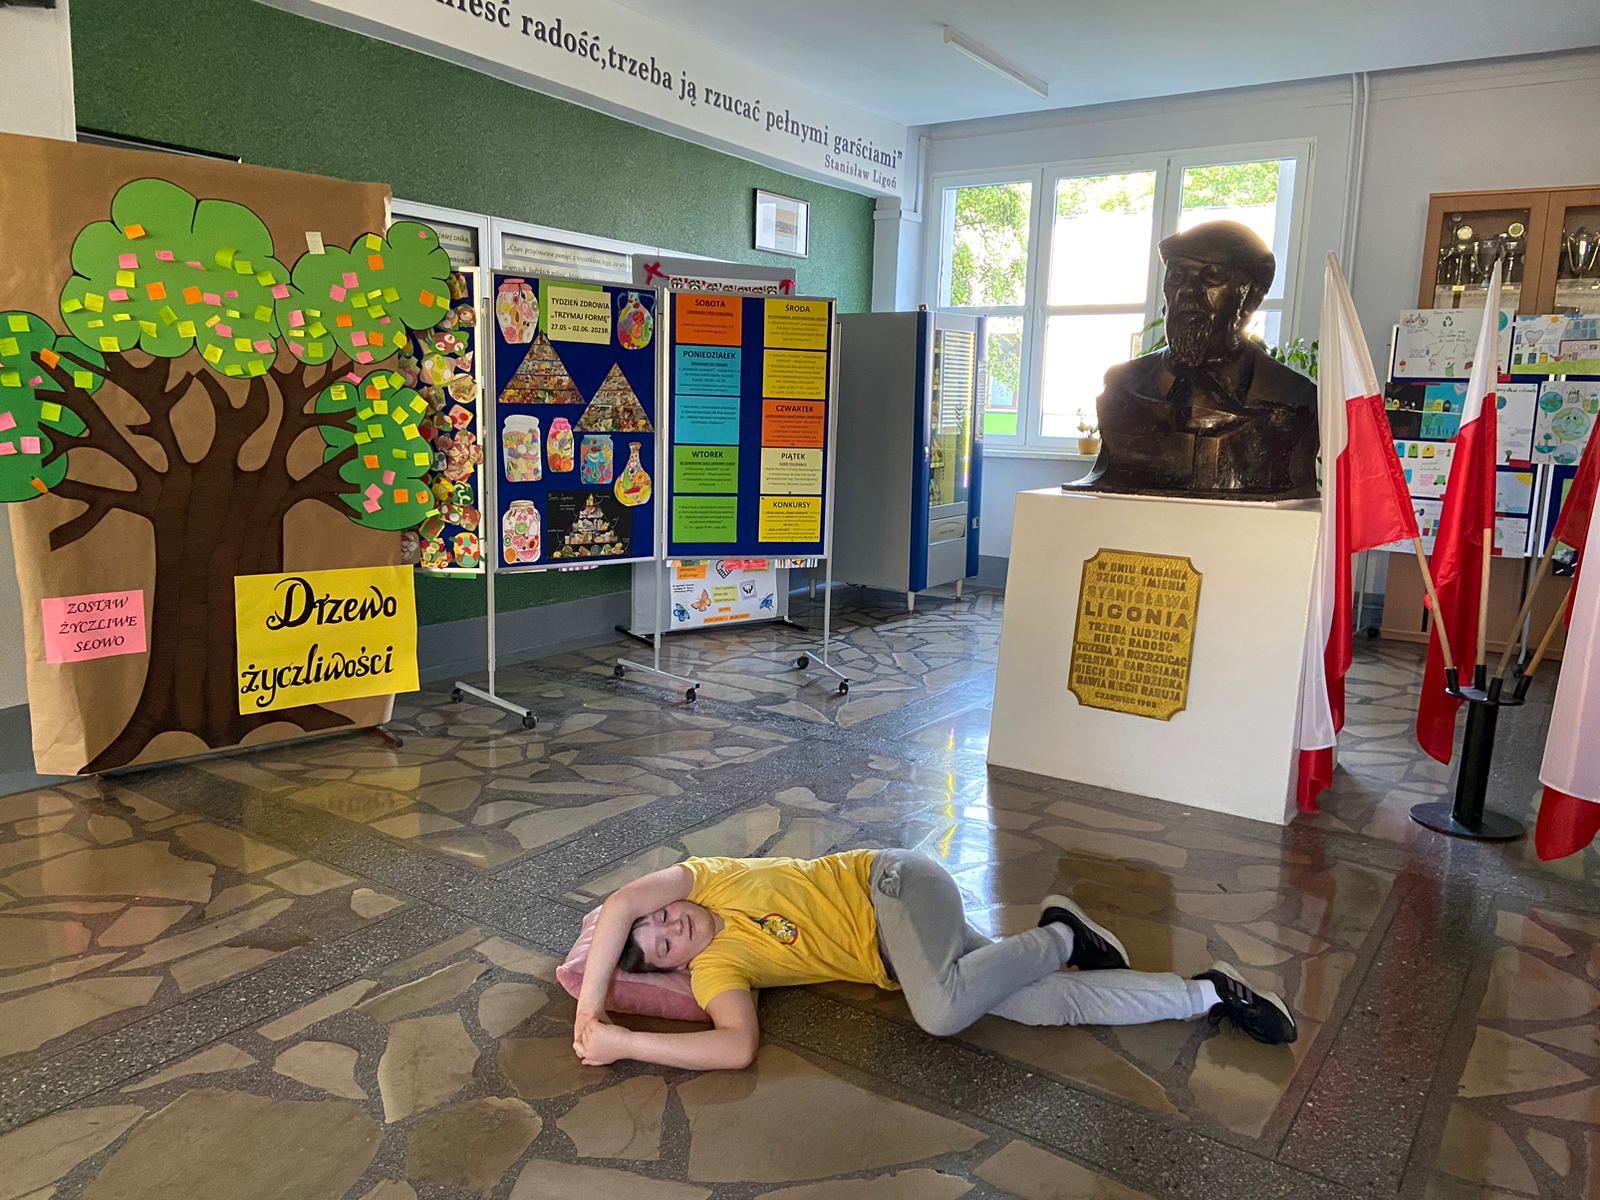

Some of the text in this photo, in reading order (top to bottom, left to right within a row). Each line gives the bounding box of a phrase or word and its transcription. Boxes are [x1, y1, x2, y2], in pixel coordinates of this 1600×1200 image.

[679, 71, 697, 107] ją
[704, 87, 761, 122] rzucać
[766, 110, 830, 146] pełnymi
[824, 154, 897, 189] Stanisław Ligoń
[551, 297, 610, 310] TYDZIEŃ ZDROWIA
[695, 299, 726, 308] SOBOTA
[551, 323, 567, 331] 27.05
[682, 350, 737, 360] PONIEDZIAŁEK
[775, 404, 814, 413] CZWARTEK
[691, 451, 724, 459] WTOREK
[781, 452, 806, 461] PIĄTEK
[773, 501, 811, 509] KONKURSY
[1097, 560, 1107, 570] W
[1110, 562, 1136, 573] DNIU
[1143, 578, 1187, 591] IMIENIA
[66, 597, 129, 614] ZOSTAW
[266, 577, 397, 631] Drzewo
[1084, 601, 1188, 629] LIGONIA
[58, 615, 138, 634] ŻYCZLIWE
[1088, 621, 1180, 643] TRZEBA LUDZIOM
[74, 635, 125, 653] SŁOWO
[240, 643, 395, 708] życzliwości
